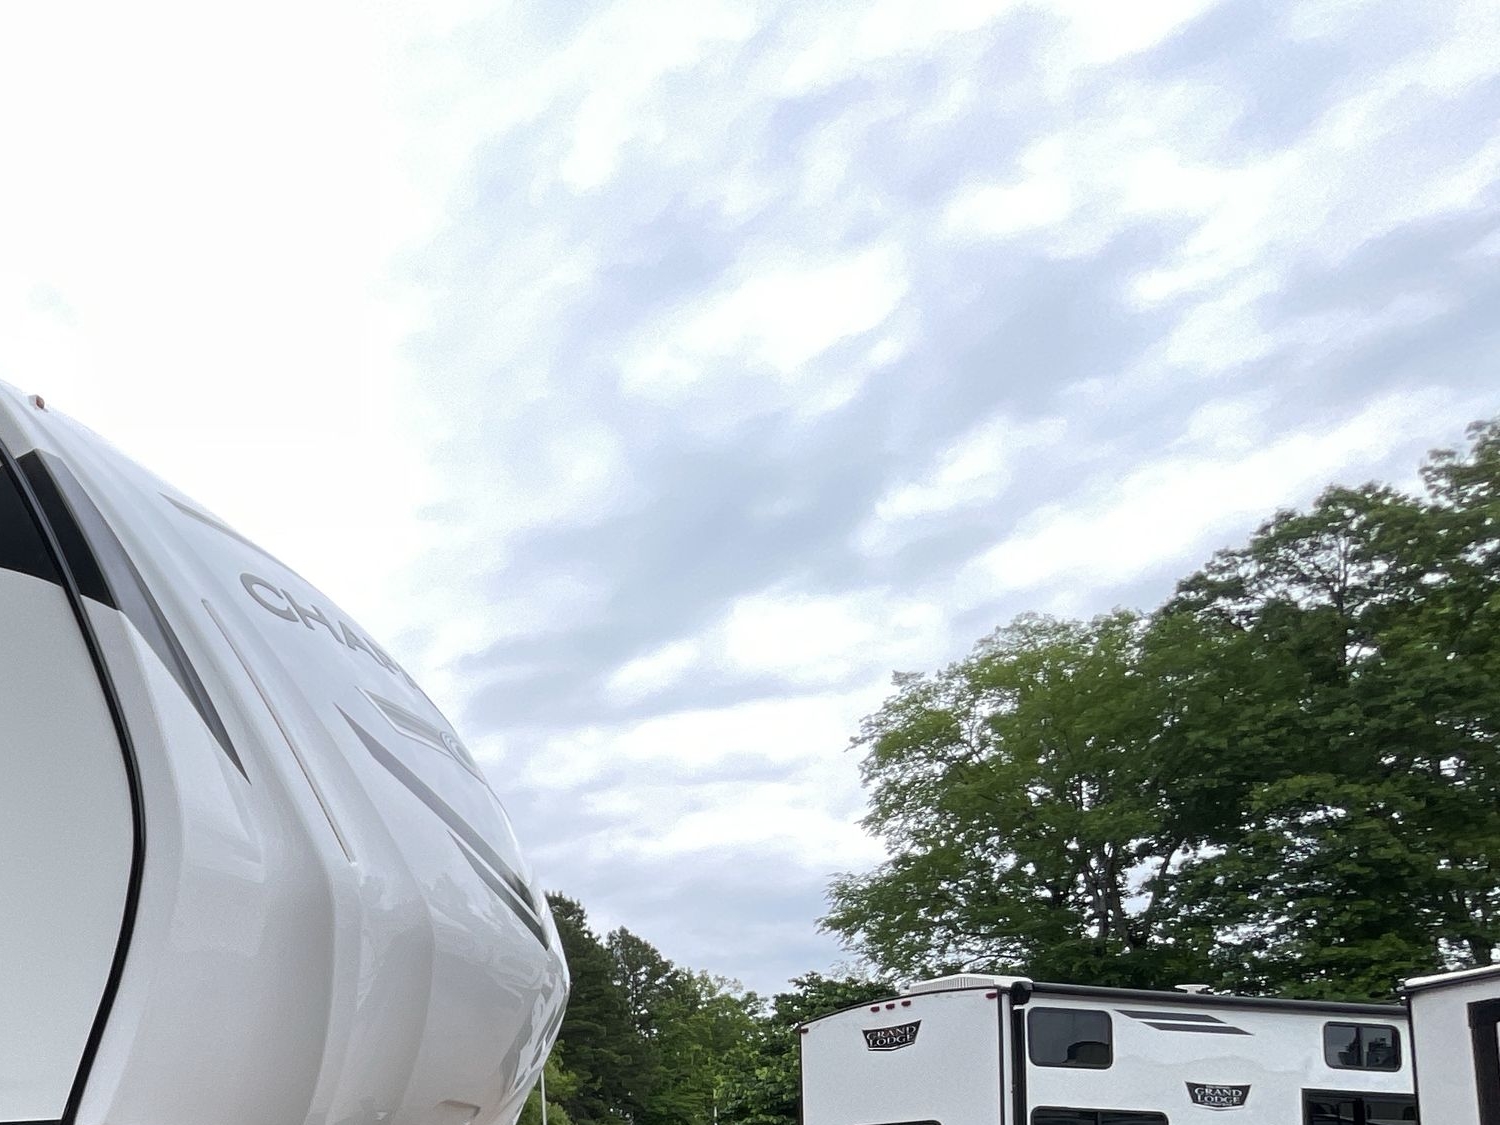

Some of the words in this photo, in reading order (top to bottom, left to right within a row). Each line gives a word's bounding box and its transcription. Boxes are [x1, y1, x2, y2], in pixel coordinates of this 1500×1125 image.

[866, 1026, 917, 1041] GRAND
[870, 1034, 915, 1047] LODGE
[1194, 1087, 1243, 1097] GRAND
[1197, 1094, 1241, 1104] LODGE
